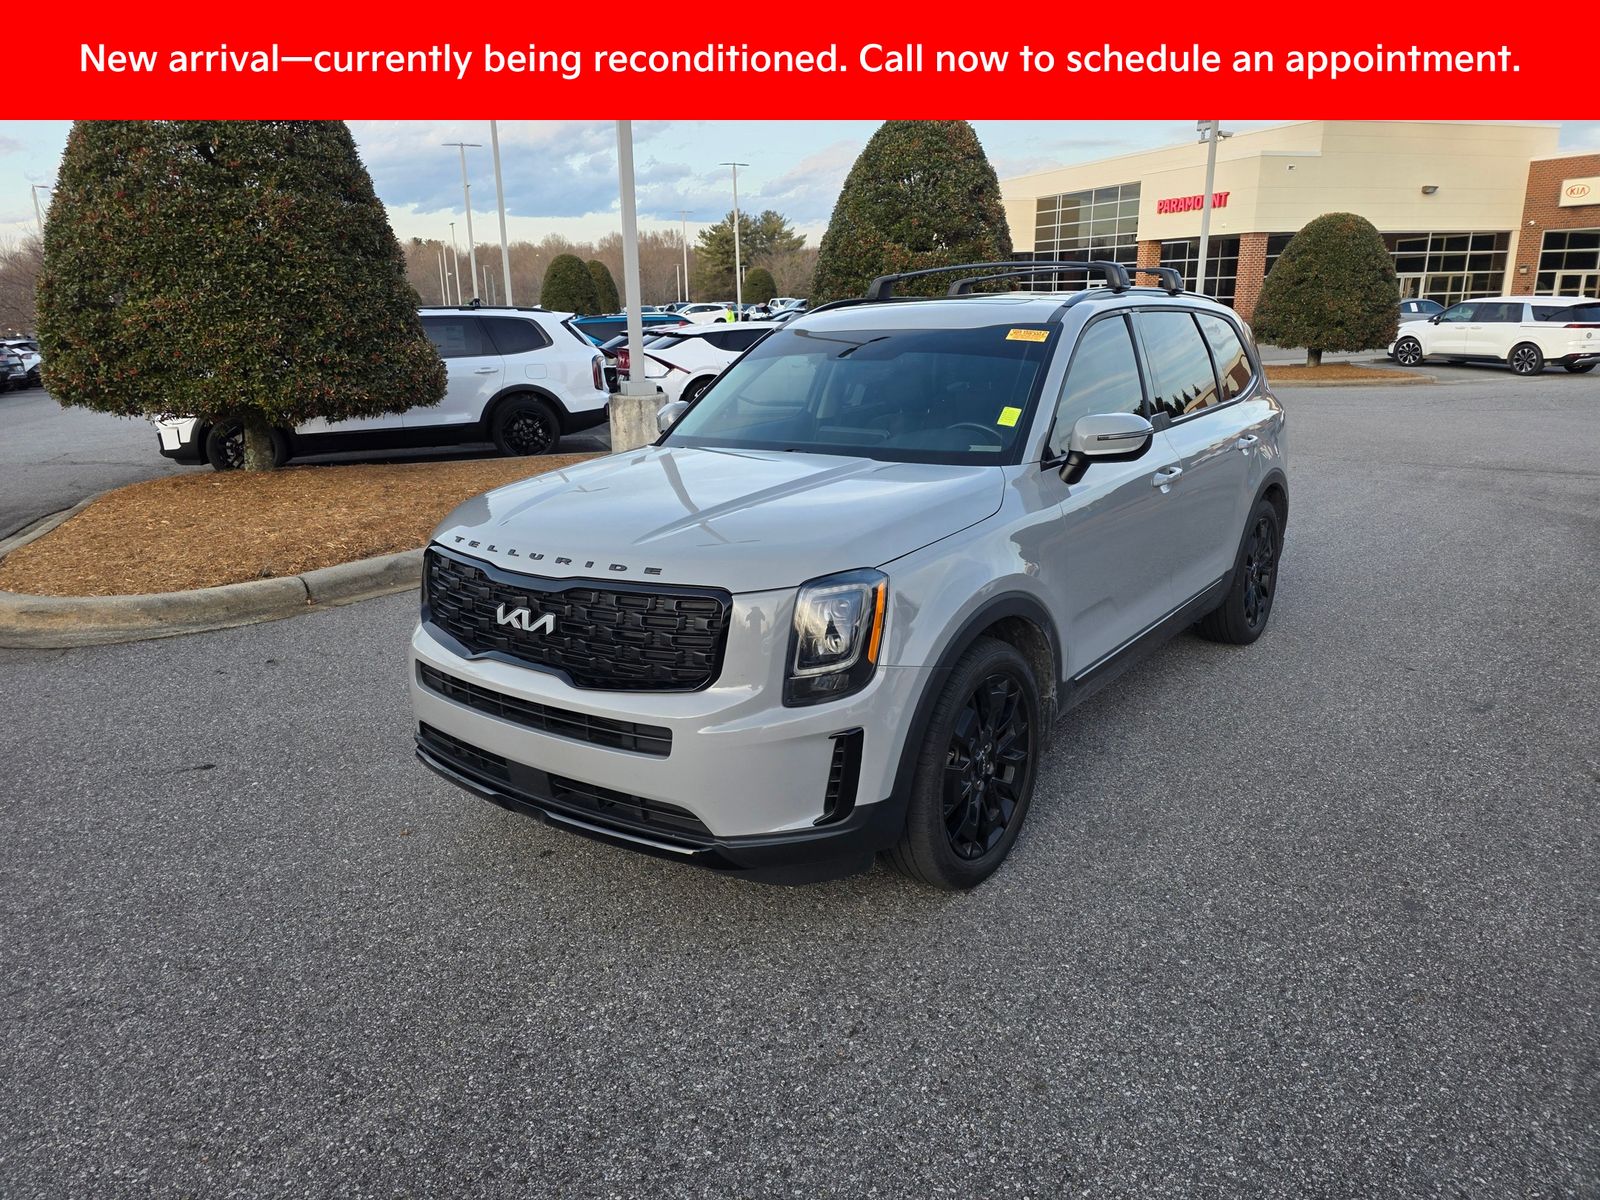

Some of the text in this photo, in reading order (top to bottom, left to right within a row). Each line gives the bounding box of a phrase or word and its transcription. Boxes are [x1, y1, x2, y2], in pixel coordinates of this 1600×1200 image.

[1157, 192, 1230, 214] PARAMONT
[454, 535, 663, 576] TELLURIDE
[496, 602, 556, 636] KIA
